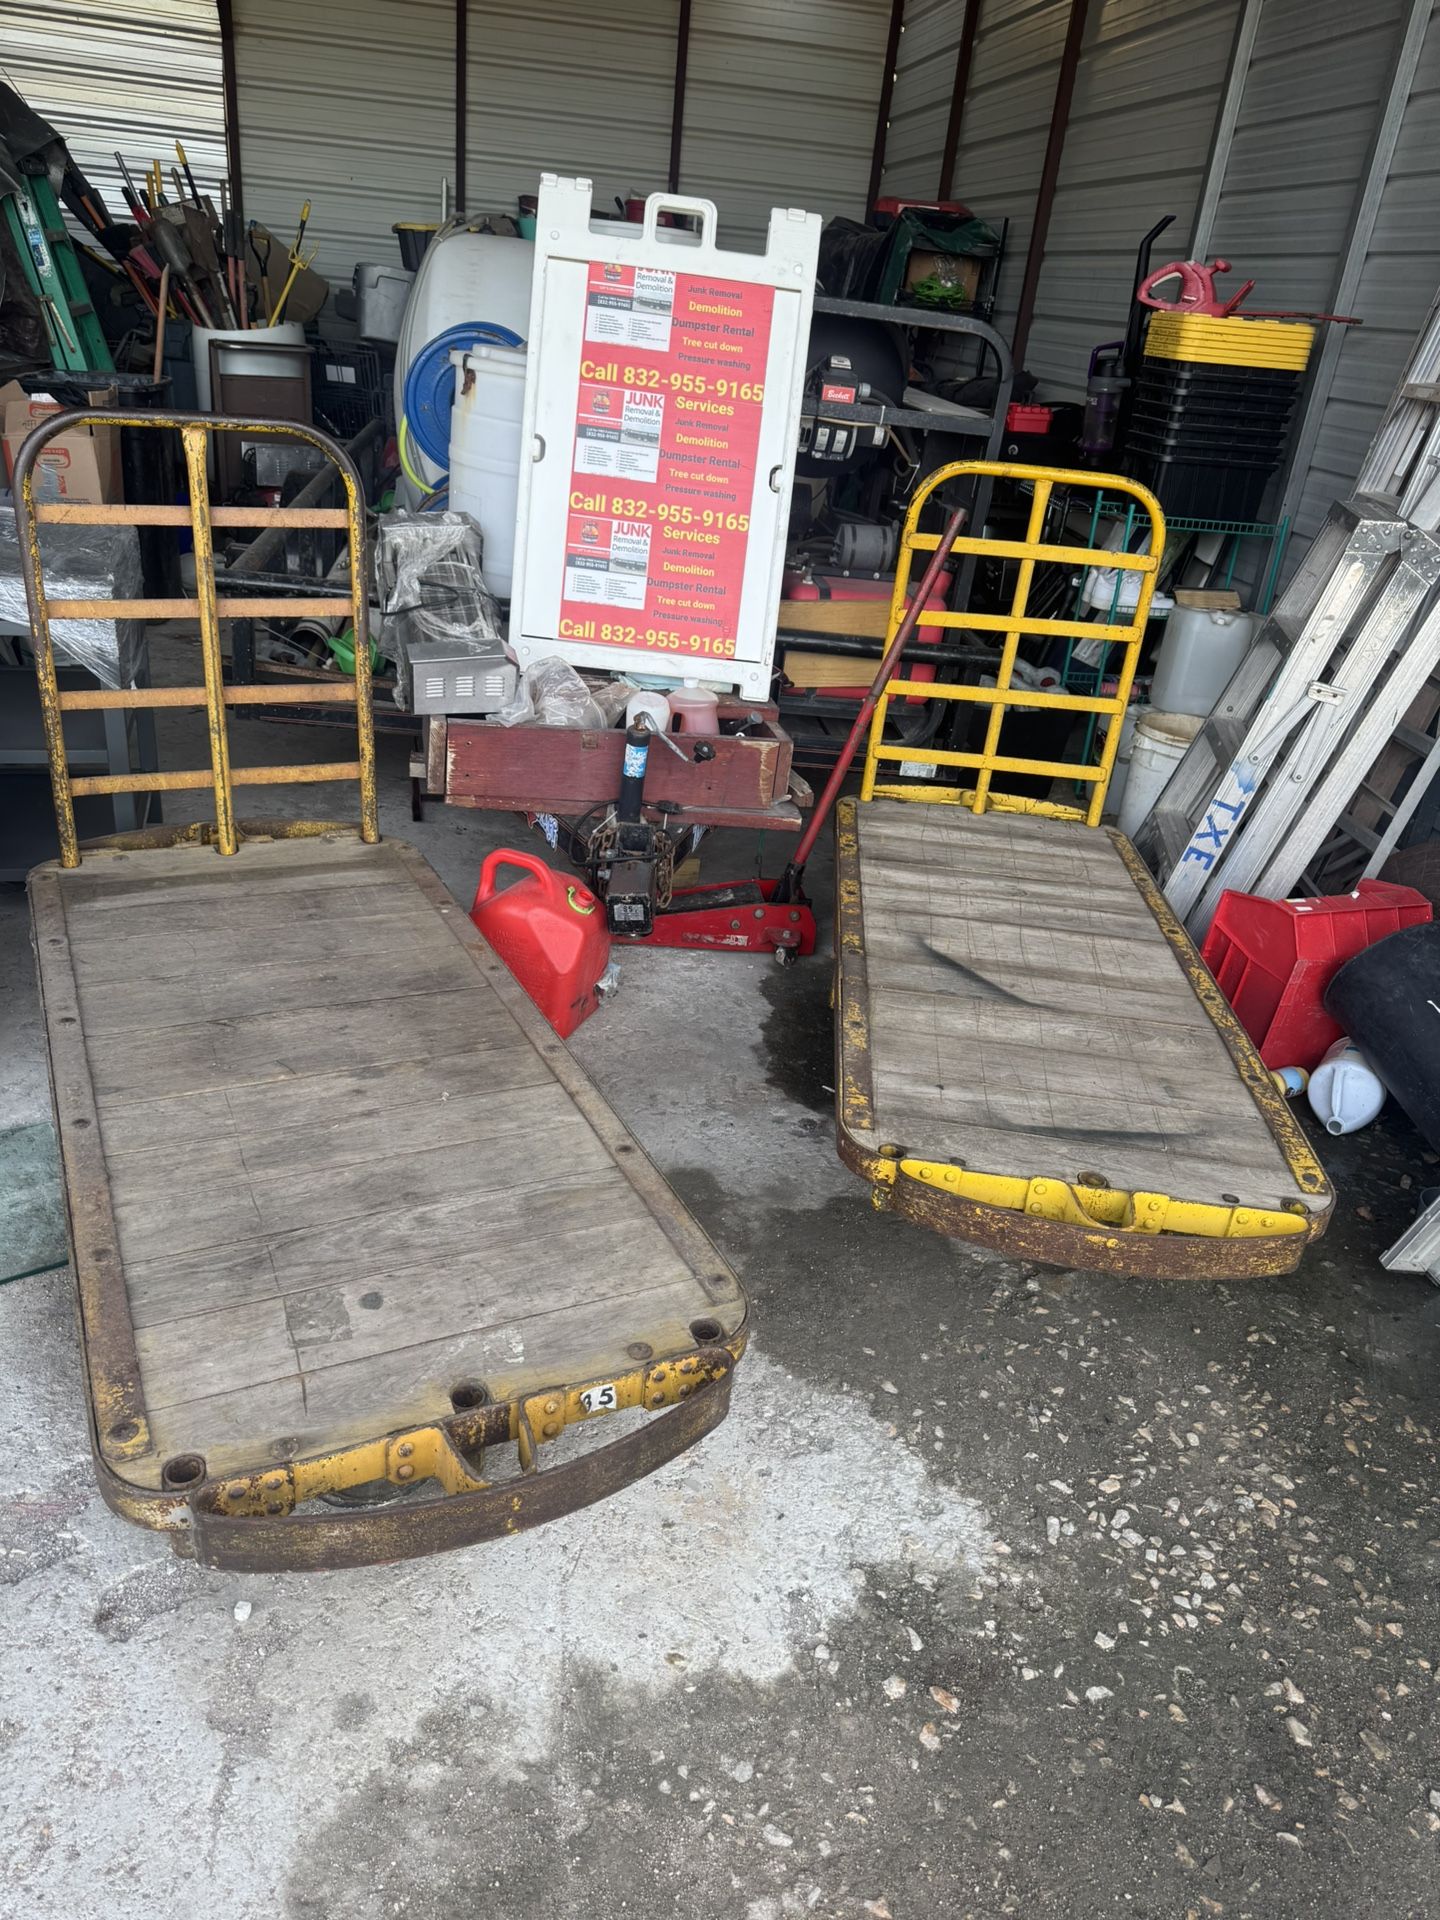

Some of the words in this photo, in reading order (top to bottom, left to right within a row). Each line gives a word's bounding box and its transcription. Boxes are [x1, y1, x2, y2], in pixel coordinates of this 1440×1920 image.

[637, 273, 665, 284] Removal
[667, 276, 673, 284] &
[635, 282, 673, 293] Demolition
[688, 285, 707, 295] Junk
[709, 288, 742, 299] Removal
[689, 301, 742, 317] Demolition
[672, 318, 719, 334] Dumpster
[723, 325, 754, 337] Rental
[683, 337, 701, 347] Tree
[703, 340, 717, 350] cut
[719, 341, 743, 353] down
[678, 352, 714, 365] Pressure
[716, 358, 751, 370] washing
[580, 361, 617, 383] Call
[624, 367, 763, 401] 832-955-9165
[626, 391, 663, 409] JUNK
[675, 396, 734, 416] Services
[625, 405, 652, 416] Removal
[654, 408, 660, 417] &
[624, 414, 660, 426] Demolition
[675, 418, 694, 427] Junk
[696, 420, 728, 431] Removal
[676, 434, 728, 449] Demolition
[660, 449, 706, 466] Dumpster
[709, 456, 740, 469] Rental
[669, 468, 688, 479] Tree
[690, 471, 704, 481] cut
[706, 472, 728, 484] down
[665, 484, 700, 495] Pressure
[703, 489, 736, 502] washing
[570, 492, 606, 513] Call
[612, 498, 749, 532] 832-955-9165
[613, 521, 651, 538] JUNK
[663, 526, 720, 544] Services
[613, 535, 640, 546] Removal
[642, 538, 648, 547] &
[612, 544, 648, 555] Demolition
[662, 547, 680, 556] Junk
[682, 549, 715, 560] Removal
[663, 562, 714, 577] Demolition
[647, 577, 693, 593] Dumpster
[696, 584, 726, 596] Rental
[657, 596, 675, 606] Tree
[677, 599, 690, 608] cut
[692, 600, 715, 611] down
[653, 610, 687, 622] Pressure
[689, 614, 722, 626] washing
[560, 619, 595, 639] Call
[601, 623, 735, 656] 832-955-9165
